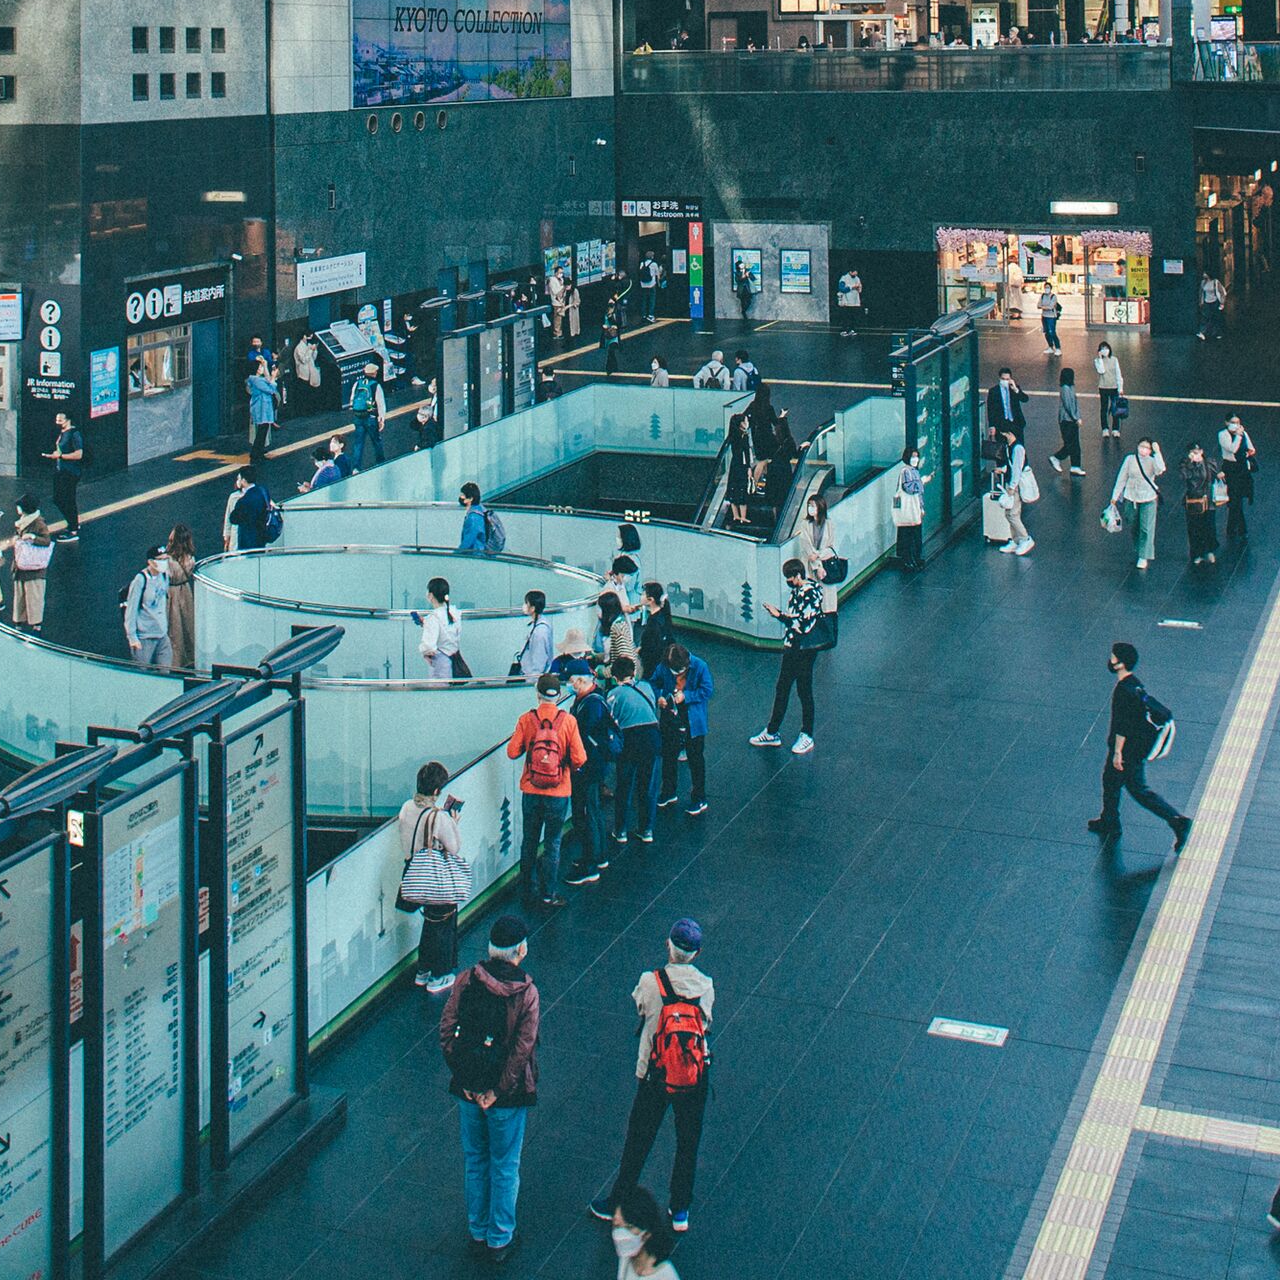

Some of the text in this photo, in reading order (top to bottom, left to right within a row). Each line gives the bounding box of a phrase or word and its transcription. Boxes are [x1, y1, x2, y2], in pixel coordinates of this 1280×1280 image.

[394, 6, 542, 35] KYOTO COLLECTION
[652, 201, 679, 210] お手洗
[652, 210, 684, 218] Restroom
[183, 284, 225, 304] 鉄道案内所
[27, 378, 76, 389] JR Information
